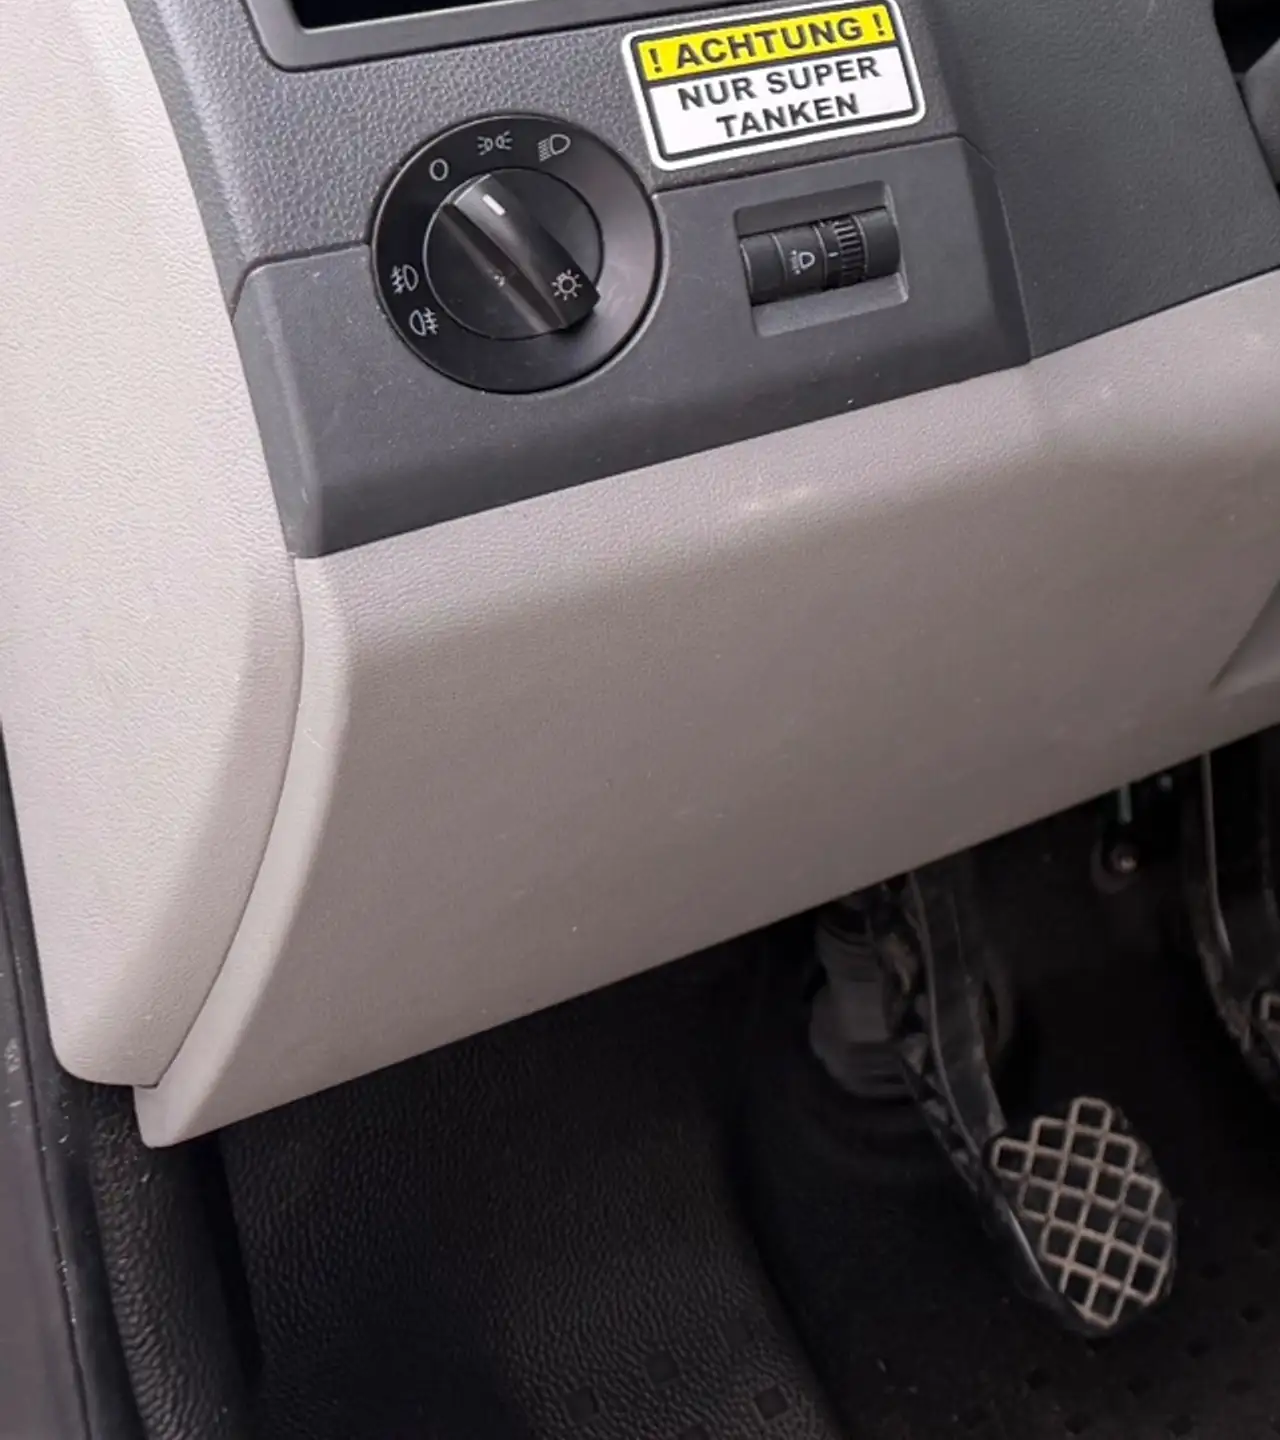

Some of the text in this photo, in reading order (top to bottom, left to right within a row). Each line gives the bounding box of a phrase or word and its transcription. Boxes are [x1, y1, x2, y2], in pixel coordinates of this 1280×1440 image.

[648, 13, 885, 72] ! ACHTUNG !
[678, 56, 882, 110] NUR SUPER
[716, 93, 860, 138] TANKEN
